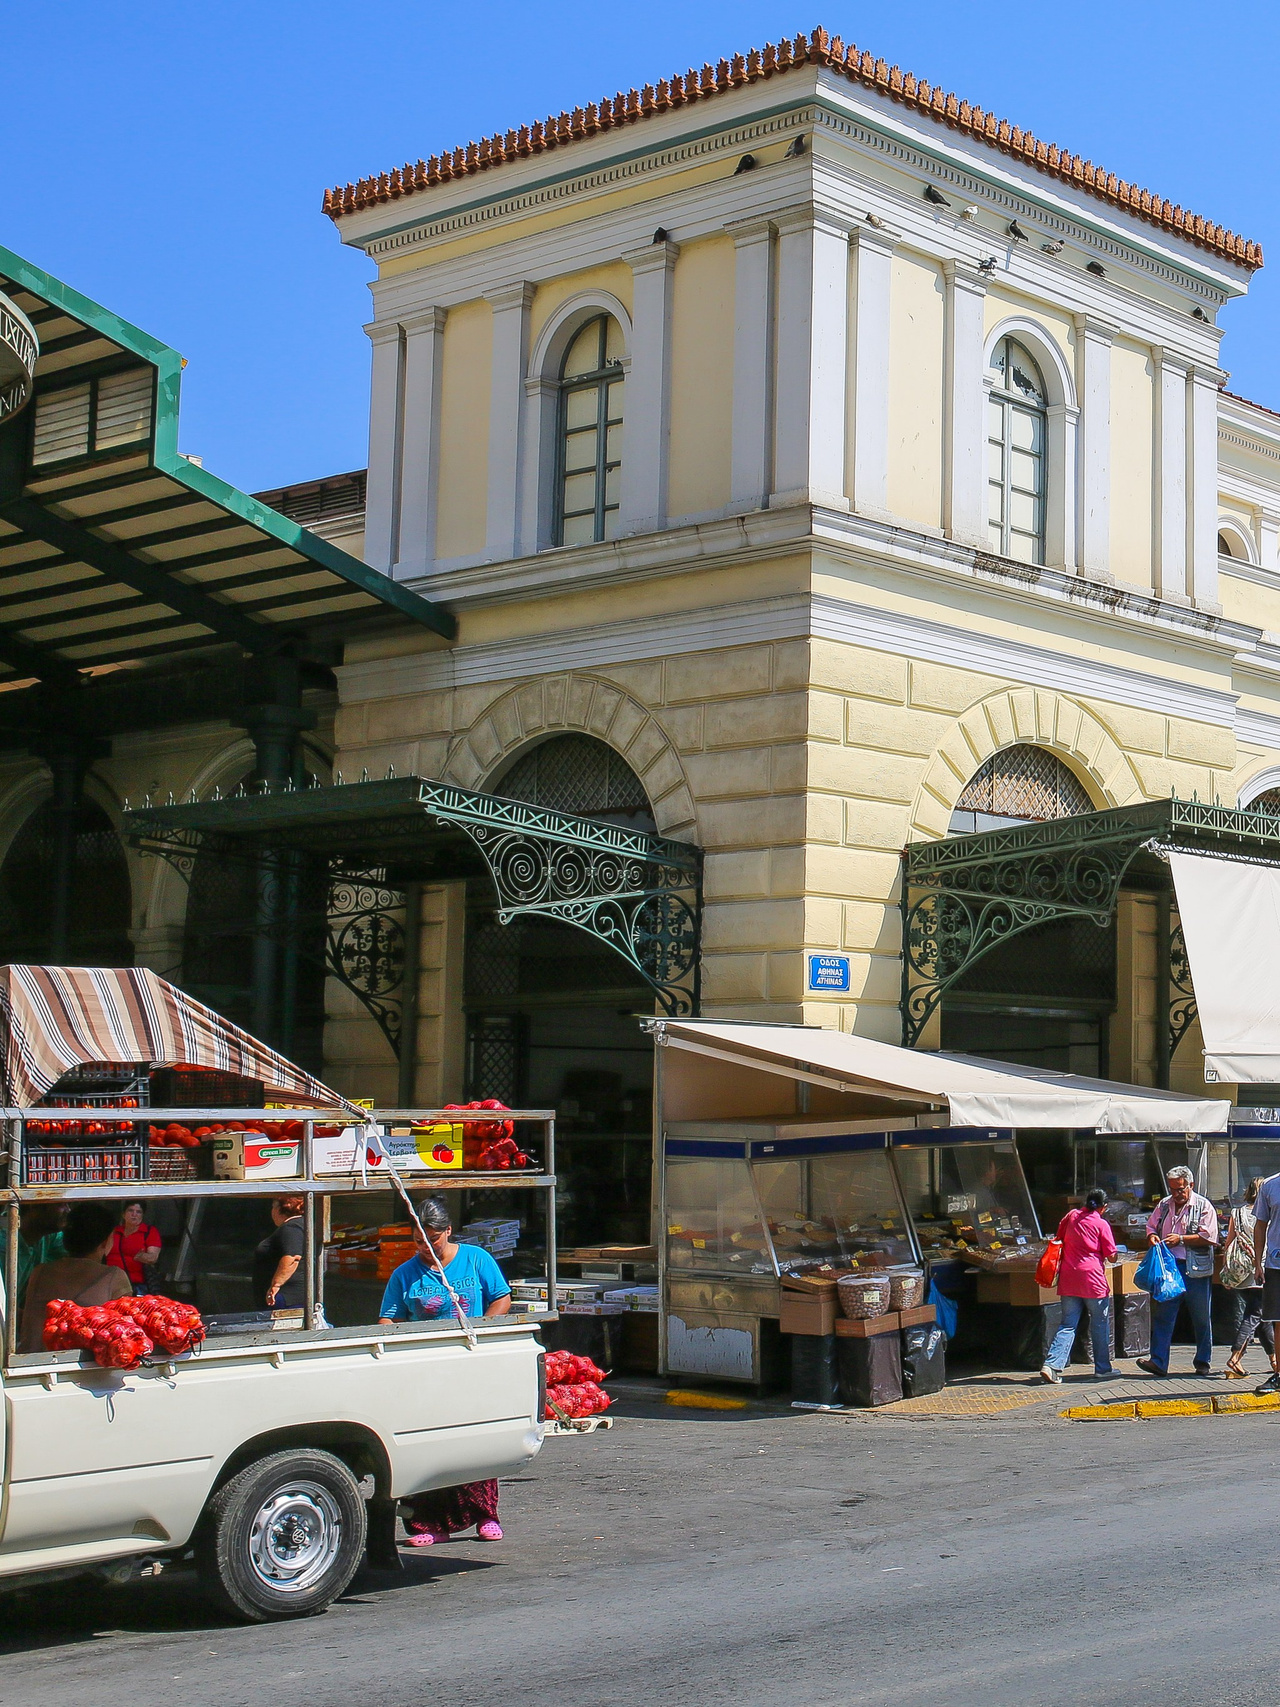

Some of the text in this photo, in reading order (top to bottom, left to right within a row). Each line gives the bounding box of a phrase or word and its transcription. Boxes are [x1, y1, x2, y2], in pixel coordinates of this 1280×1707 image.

[820, 958, 840, 967] ΟΔΟΣ
[817, 967, 844, 976] ΑΘΗΝΑΣ
[816, 977, 843, 986] ATHINAS
[413, 1277, 475, 1297] LOVE CLSSICS
